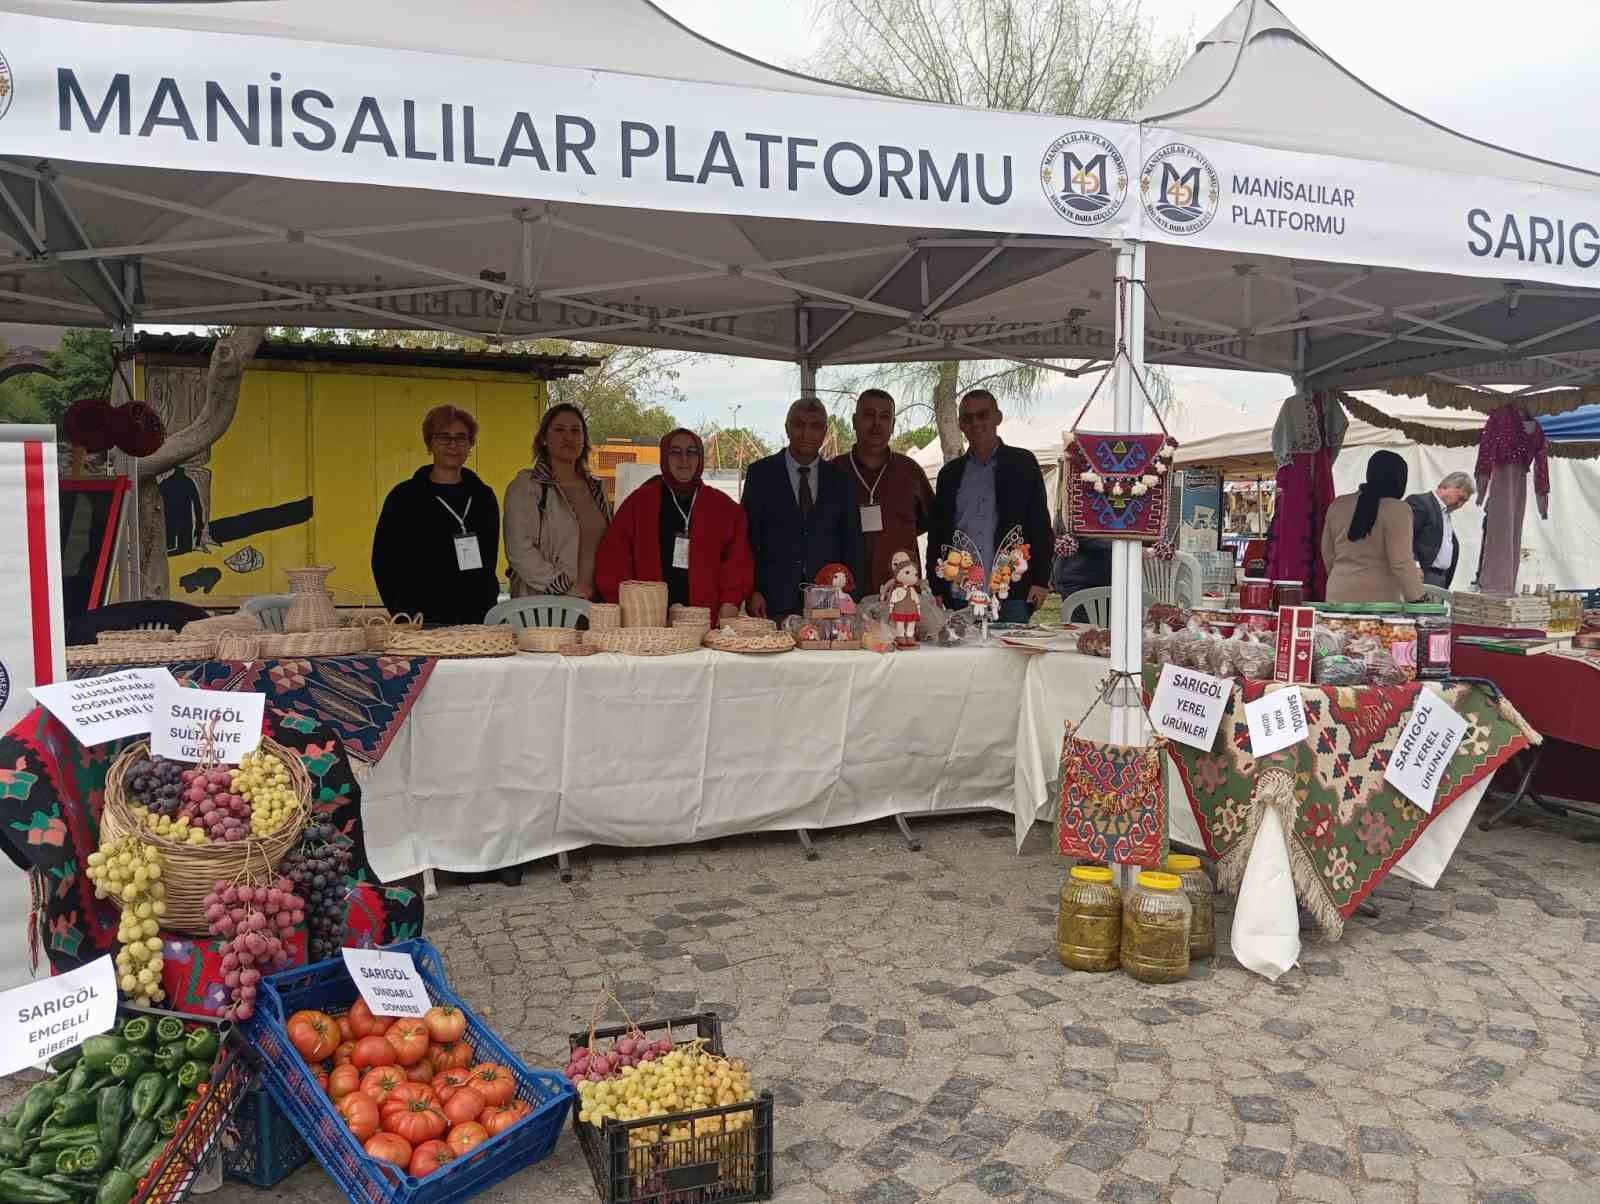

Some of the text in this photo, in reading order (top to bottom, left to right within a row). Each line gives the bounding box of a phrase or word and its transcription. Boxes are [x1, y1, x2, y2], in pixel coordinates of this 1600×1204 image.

[57, 68, 1014, 205] MANİSALILAR PLATFORMU
[1232, 175, 1354, 208] MANİSALILAR
[1232, 205, 1345, 235] PLATFORMU
[1467, 208, 1600, 269] SARIG
[73, 675, 124, 689] ULUSAL
[1172, 673, 1223, 699] SARIGÖL
[170, 704, 245, 723] SARIGÖL
[1177, 698, 1208, 718] YEREL
[1287, 694, 1304, 733] SARIGÖL
[1162, 713, 1208, 740] ÜRÜNLERİ
[1394, 705, 1433, 771] SARIGÖL
[1413, 729, 1440, 769] YEREL
[360, 966, 411, 981] SARIGÖL
[18, 985, 99, 1023] SARIGÖL
[38, 1031, 79, 1058] BİBERİ
